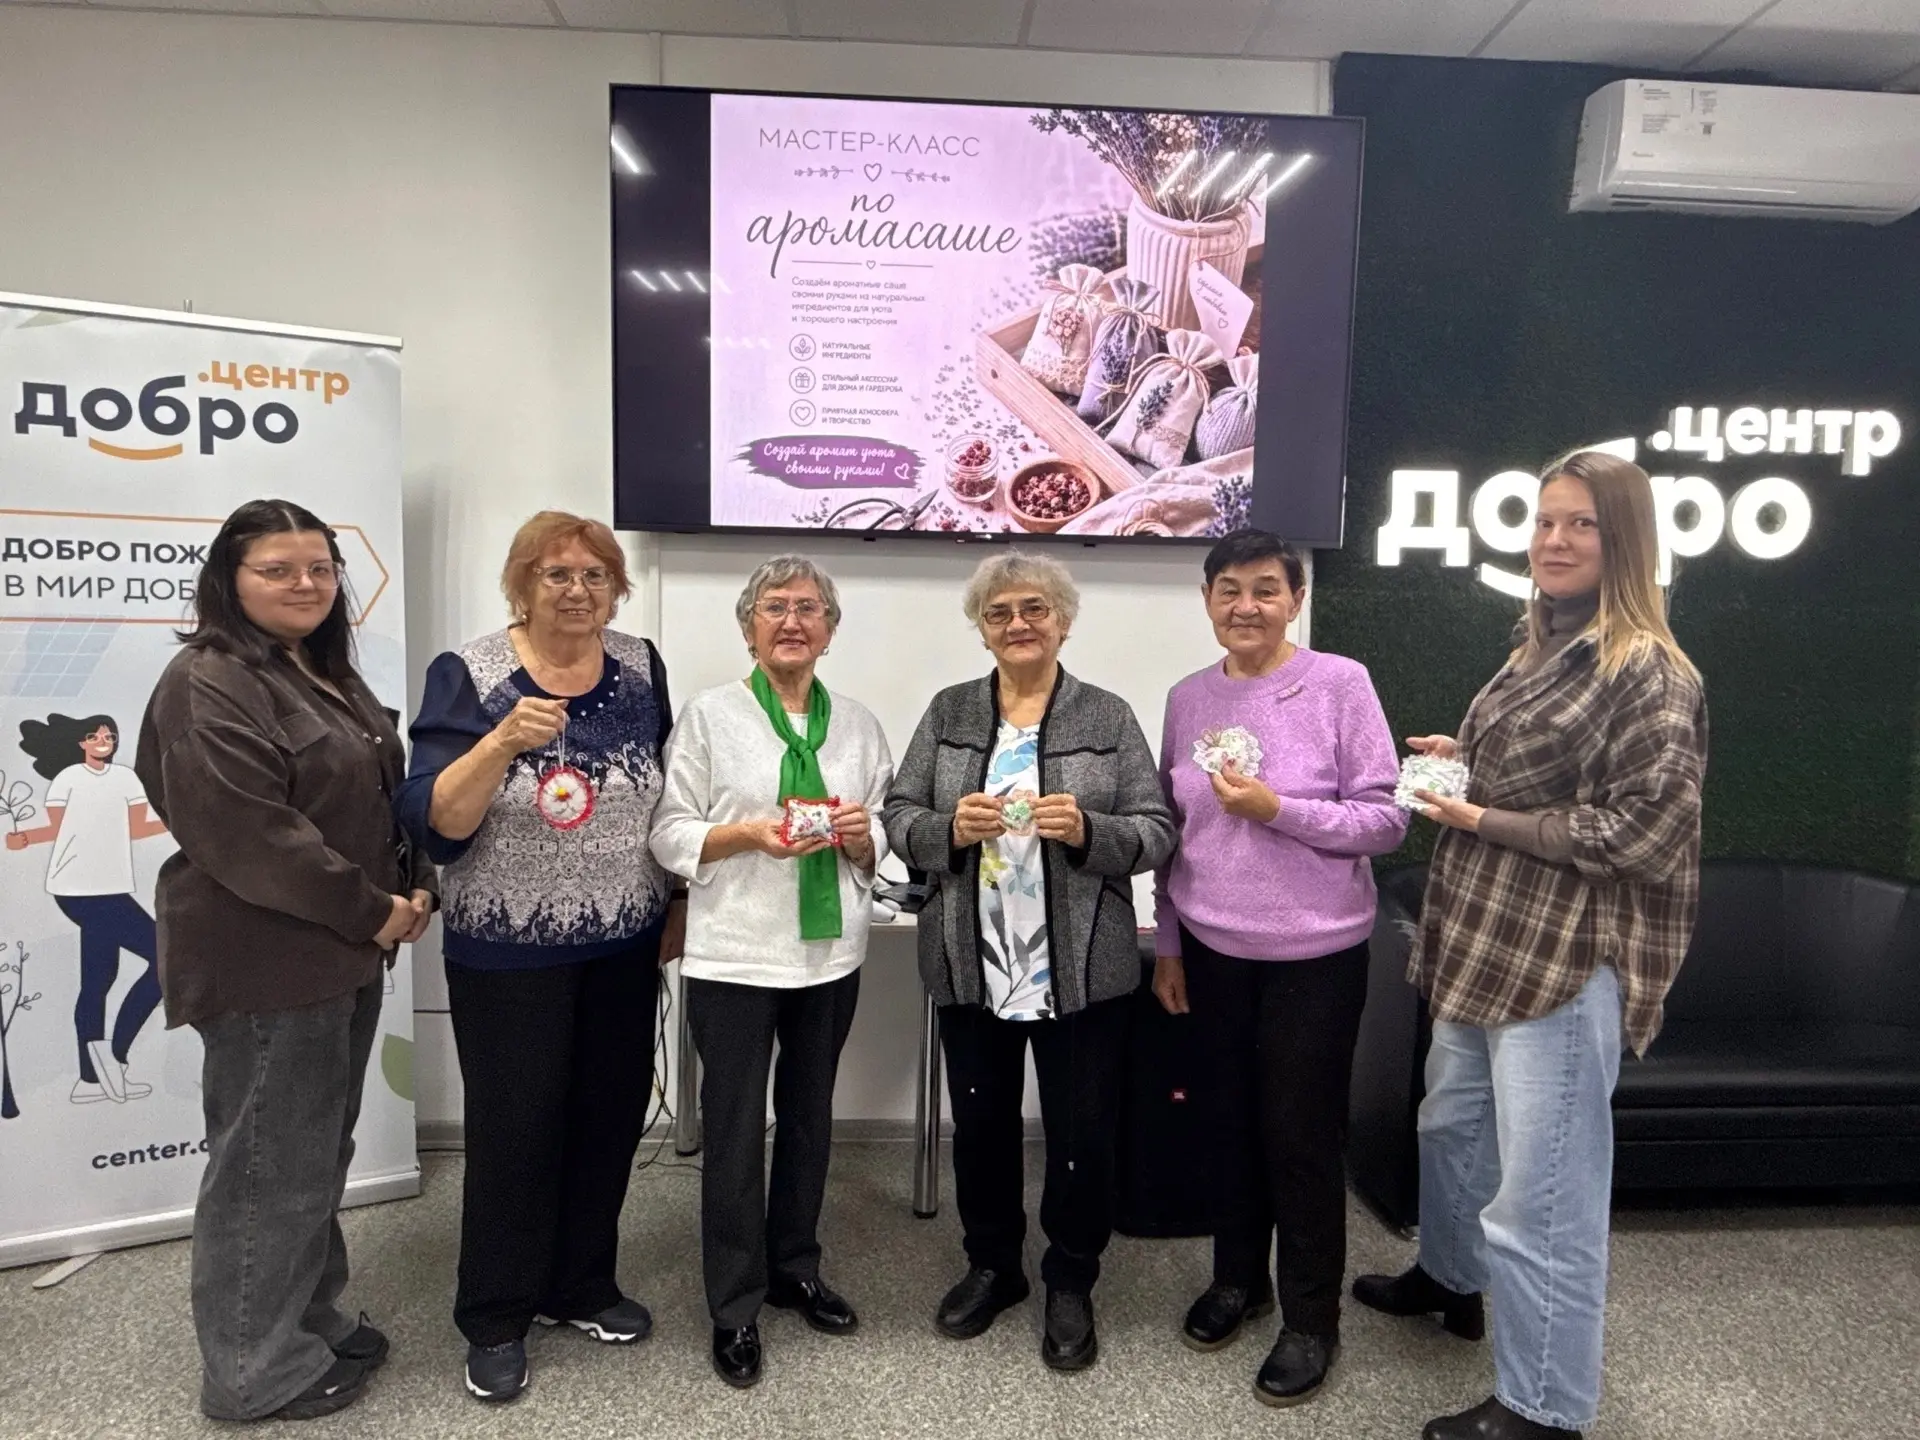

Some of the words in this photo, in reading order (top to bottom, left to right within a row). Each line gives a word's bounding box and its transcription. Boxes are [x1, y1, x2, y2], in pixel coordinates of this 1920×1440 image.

[759, 127, 980, 157] МАСТЕР-КЛАСС
[850, 193, 895, 213] по
[746, 209, 1022, 279] аромасаше
[791, 290, 824, 299] своими
[826, 292, 858, 301] руками
[853, 305, 869, 313] для
[871, 306, 893, 315] уюта
[801, 316, 846, 325] хорошего
[847, 317, 898, 326] настроения
[822, 342, 871, 350] НАТУРАЛЬНЫЕ
[821, 383, 837, 391] ДЛЯ
[14, 375, 299, 456] добро
[858, 408, 900, 417] АТМОСФЕРА
[763, 443, 807, 461] Создай
[809, 446, 858, 462] аромат
[860, 448, 896, 463] уюта
[785, 460, 831, 474] своими
[835, 463, 885, 480] руками!
[1377, 438, 1812, 586] доро
[2, 538, 121, 563] ДОБРО
[5, 574, 25, 597] В
[37, 575, 115, 598] МИР
